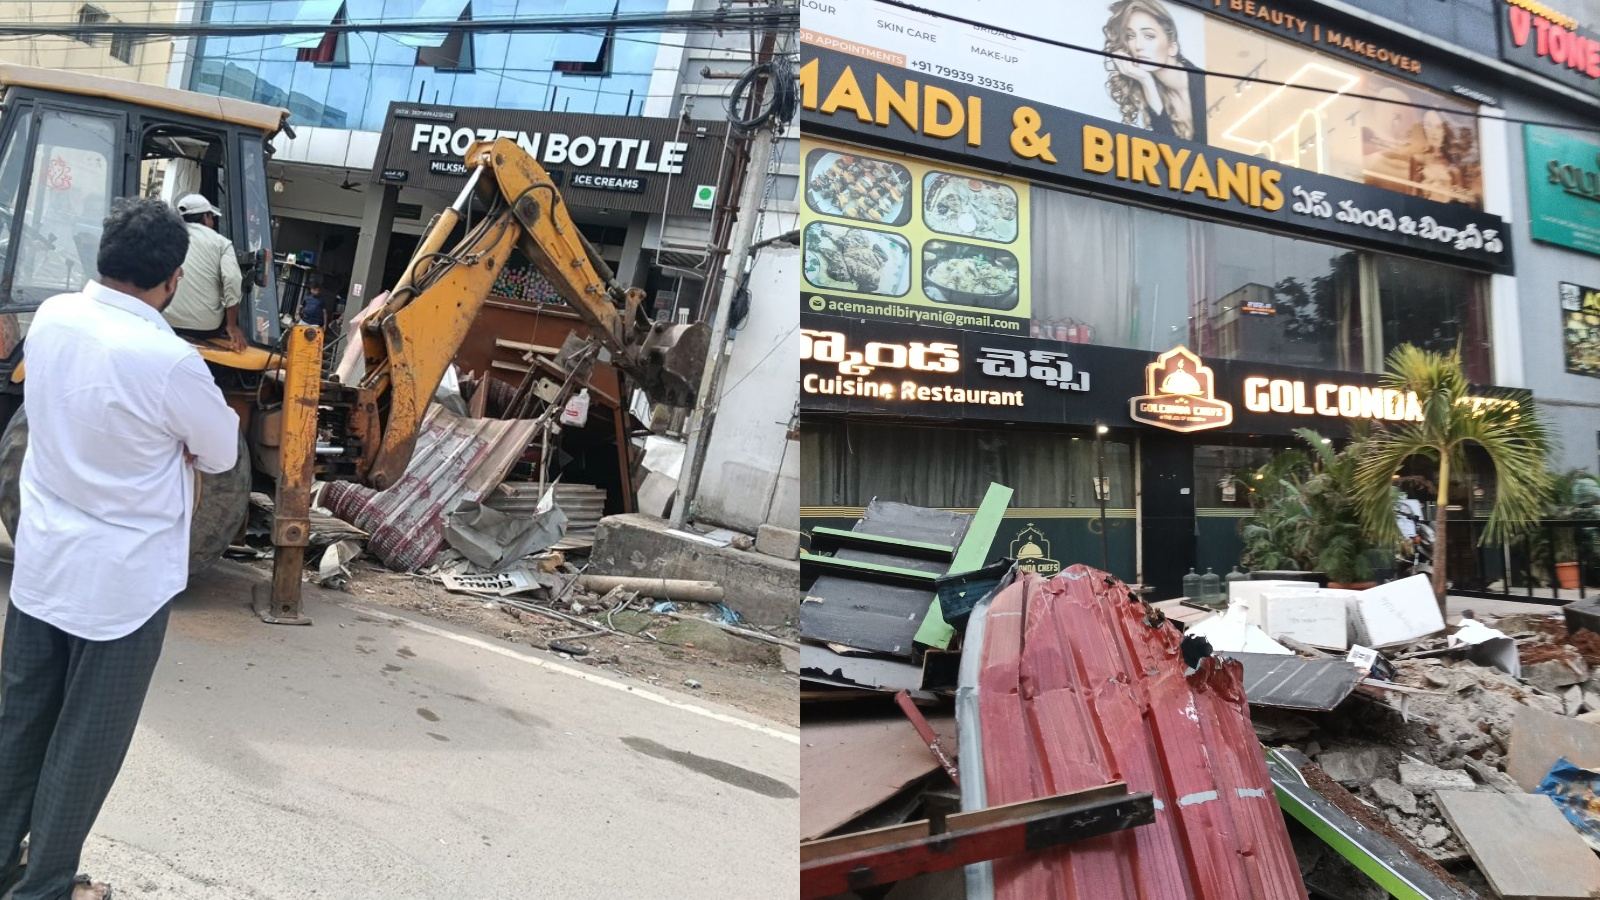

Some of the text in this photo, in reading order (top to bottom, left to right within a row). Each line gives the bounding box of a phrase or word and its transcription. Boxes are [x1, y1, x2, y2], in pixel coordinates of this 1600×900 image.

[877, 19, 937, 43] SKIN CARE
[1230, 0, 1307, 33] BEAUTY
[1327, 30, 1421, 74] MAKEOVER
[815, 36, 904, 65] APPOINTMENTS
[971, 45, 1019, 63] MAKE-UP
[911, 60, 1014, 93] +91 79939 39336
[411, 123, 688, 174] FRON BOTTLE
[1010, 105, 1058, 164] &
[1082, 124, 1284, 212] BIRYANIS
[431, 161, 468, 173] MILKSH
[574, 174, 639, 189] ICE CREAMS
[1335, 200, 1397, 231] మంది
[828, 300, 1020, 331] acemandibiryani@gmail.com
[803, 373, 1024, 407] Cuisine Restaurant
[1244, 376, 1425, 422] GOLCONDA
[1037, 563, 1059, 572] CHEFS
